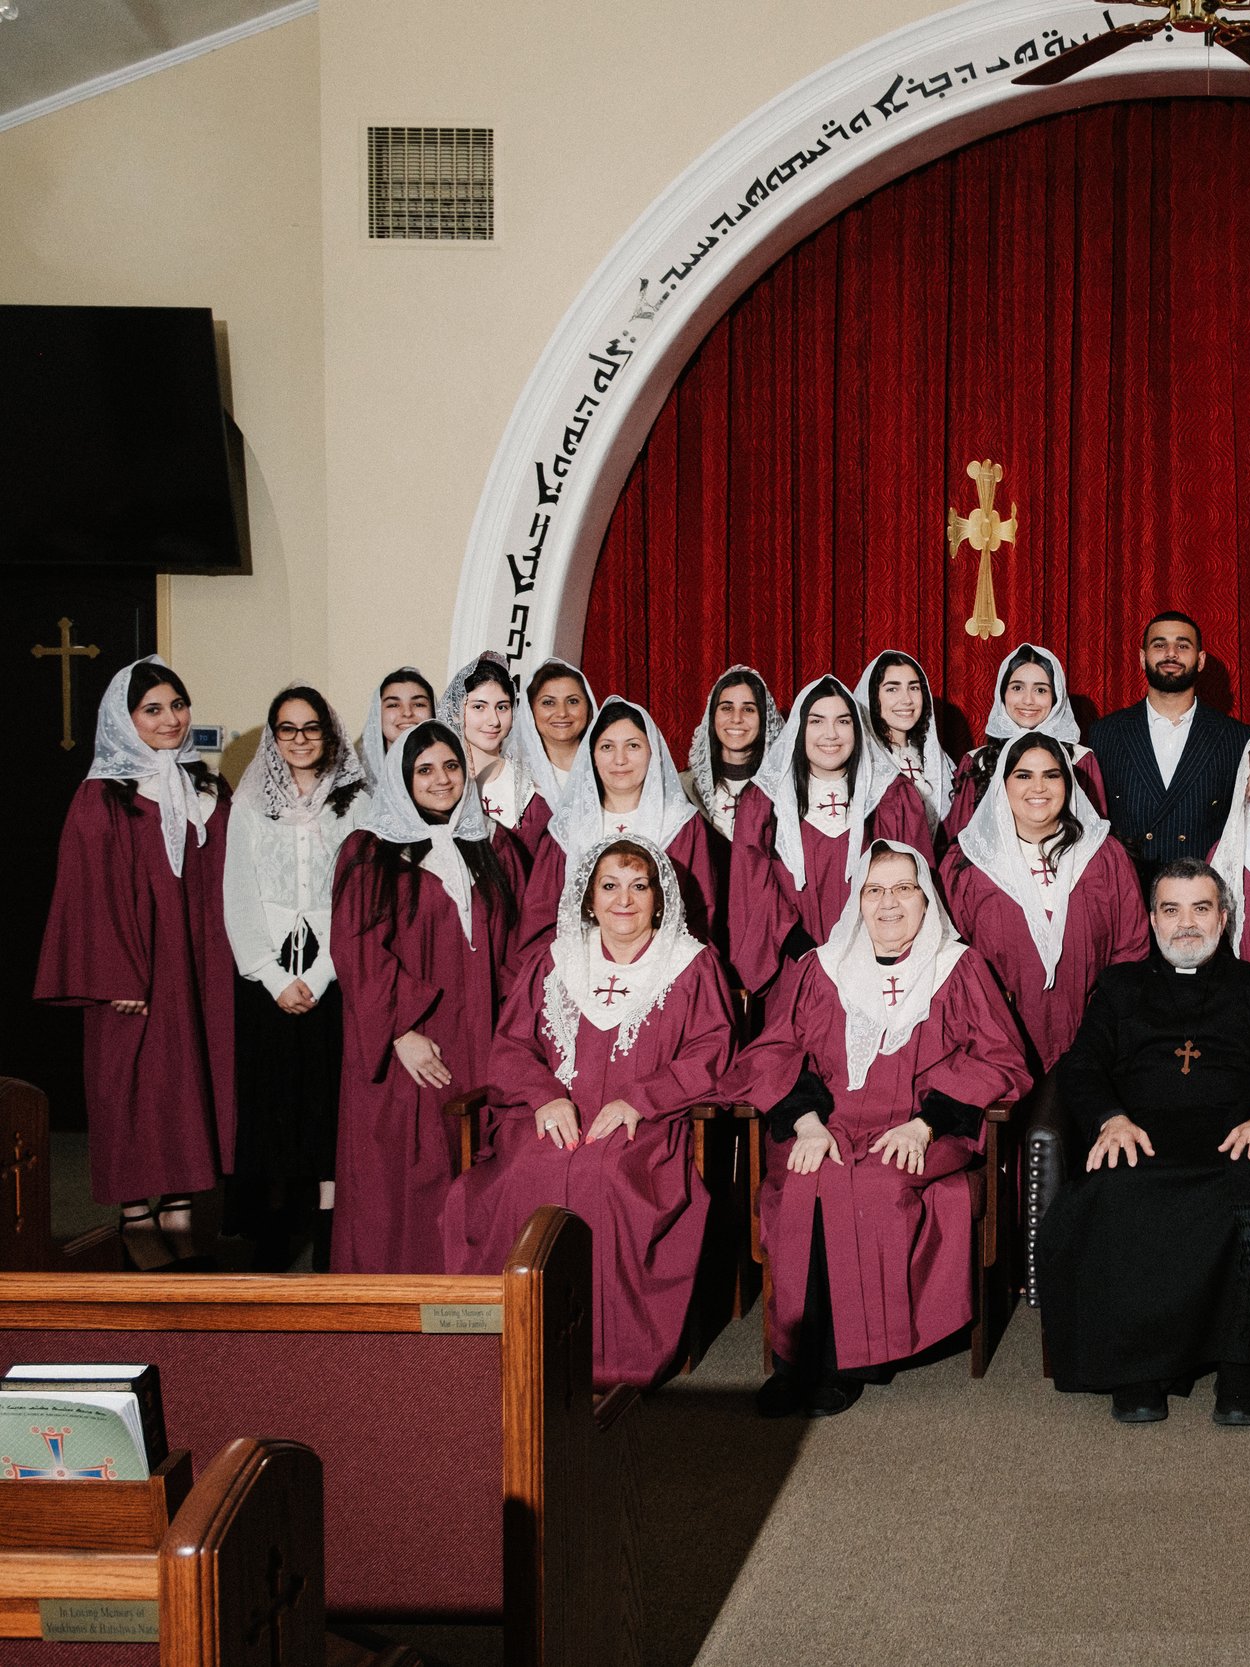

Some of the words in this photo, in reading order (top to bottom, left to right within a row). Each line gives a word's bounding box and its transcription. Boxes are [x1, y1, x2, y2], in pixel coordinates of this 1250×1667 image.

[441, 1309, 460, 1318] Loving
[462, 1309, 484, 1318] Memory
[59, 1606, 68, 1617] In
[70, 1606, 99, 1620] Loving
[100, 1607, 134, 1621] Memory
[136, 1607, 145, 1618] of
[89, 1622, 97, 1634] &
